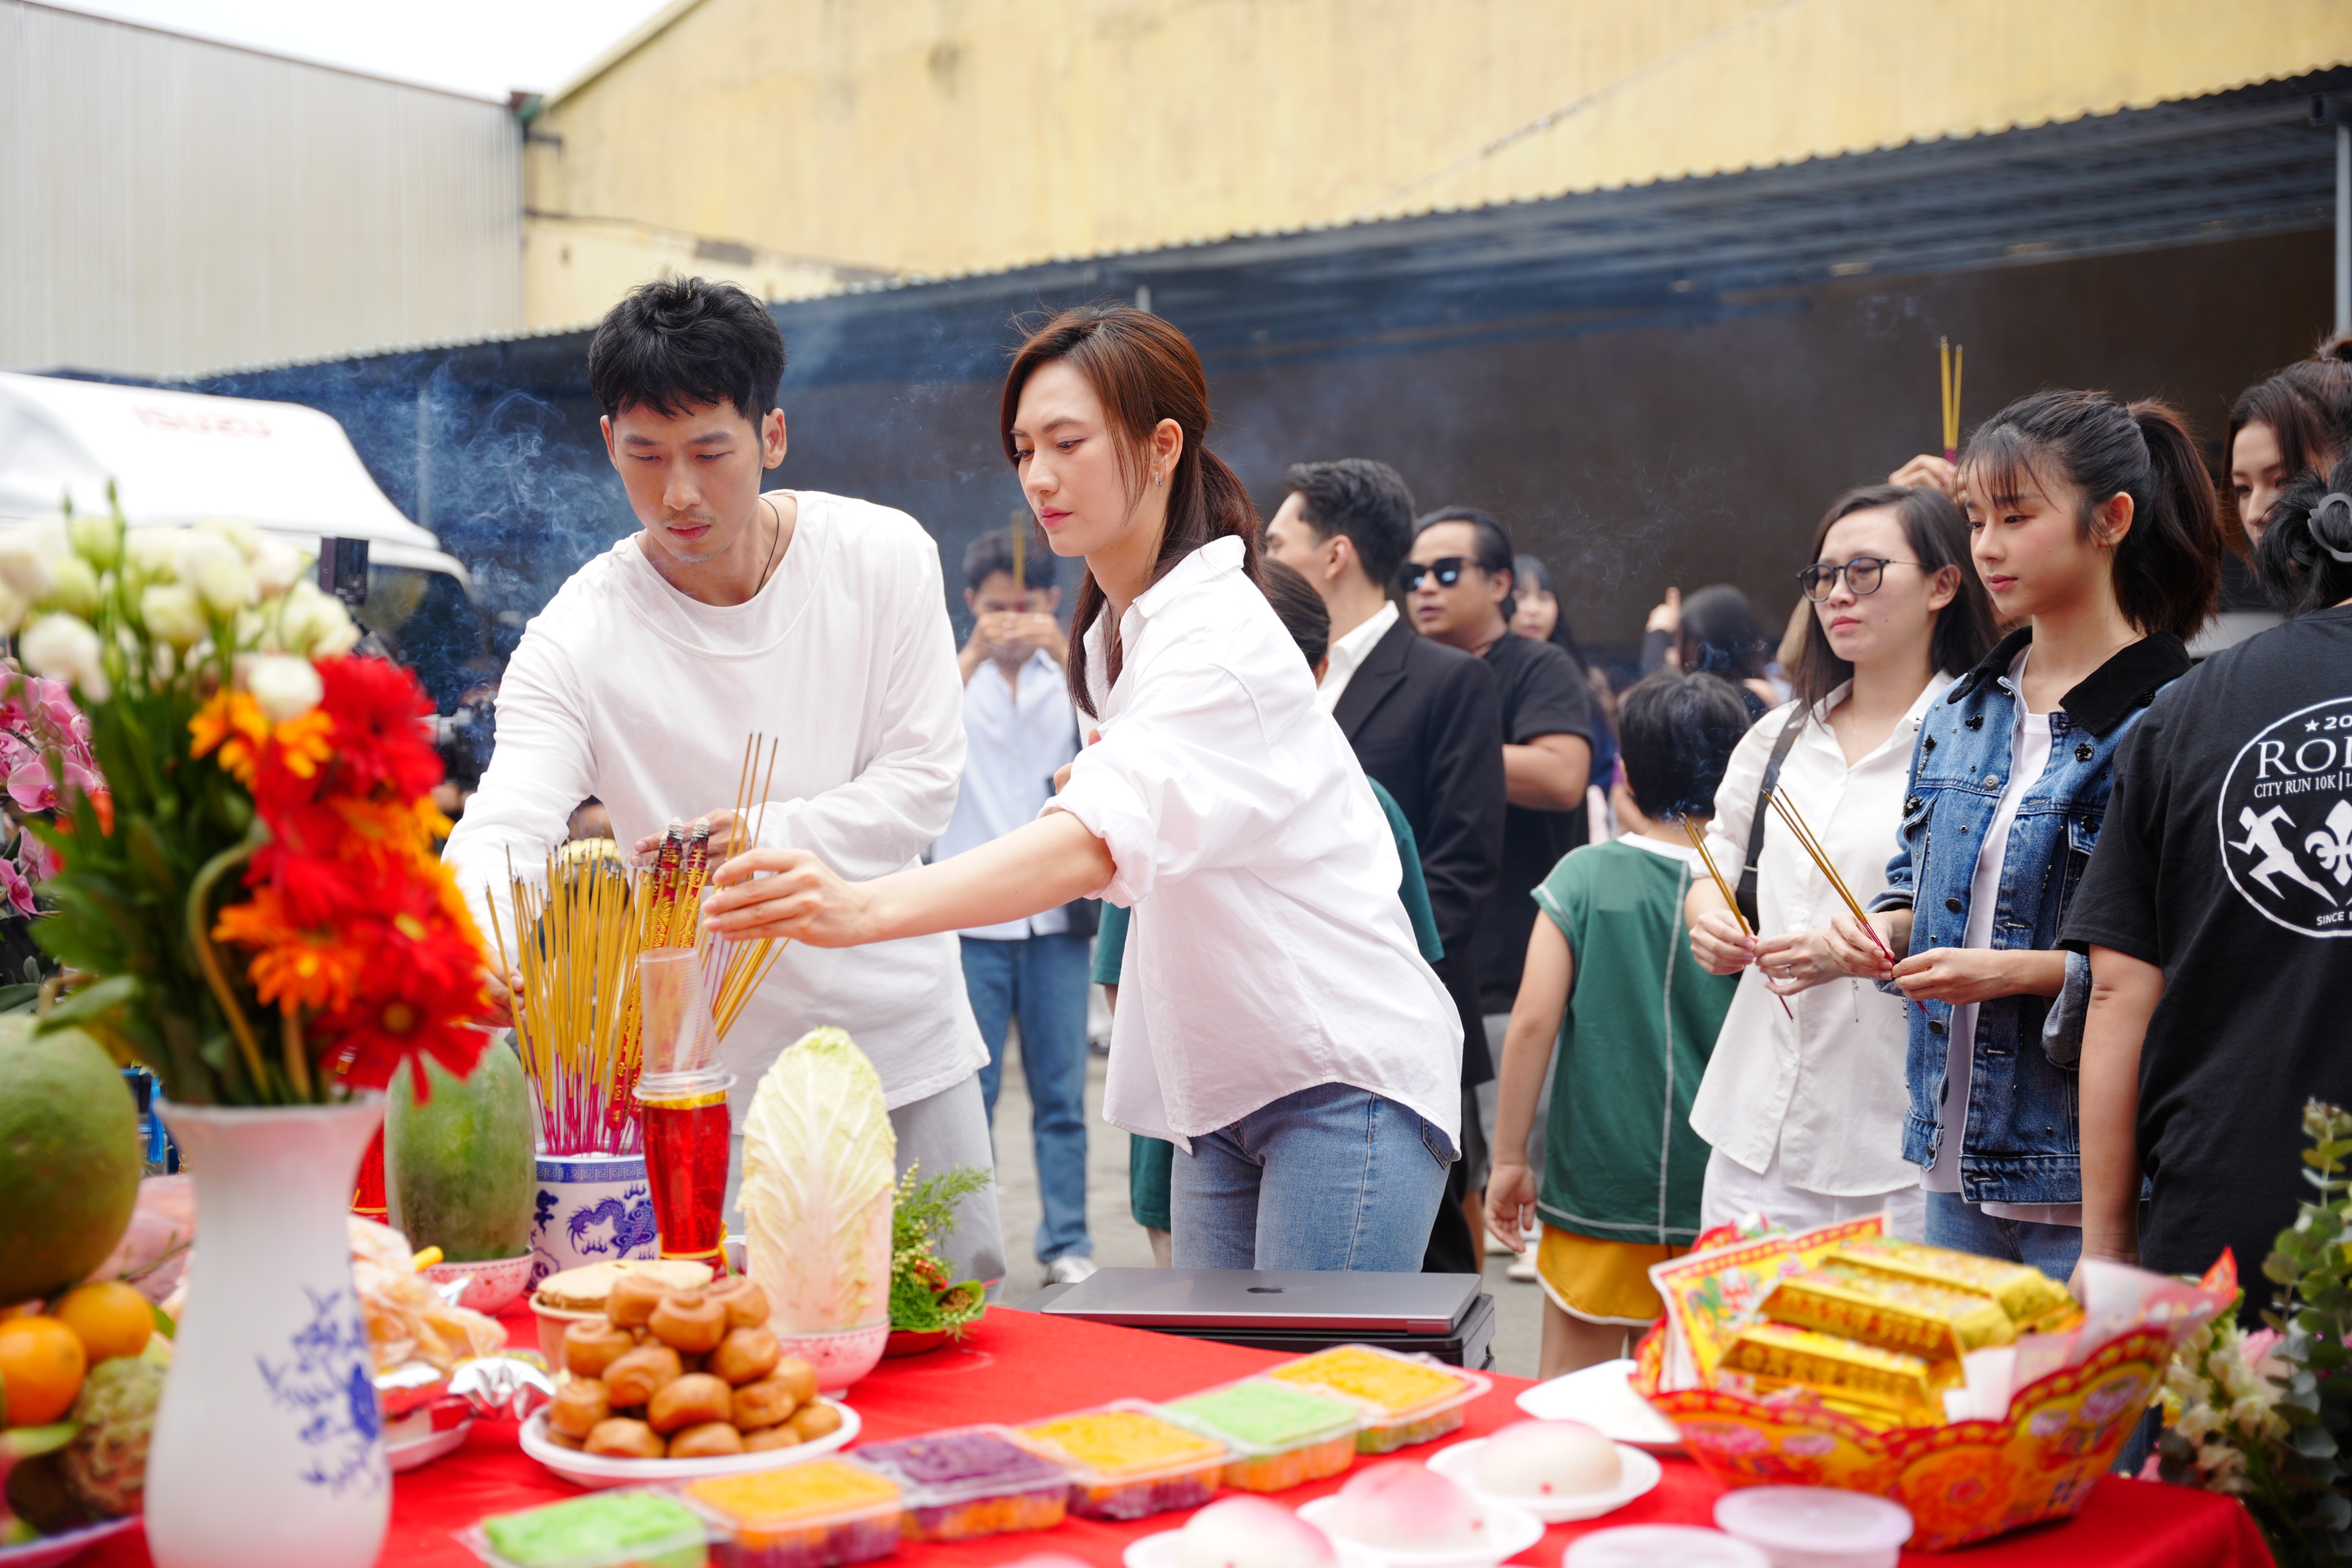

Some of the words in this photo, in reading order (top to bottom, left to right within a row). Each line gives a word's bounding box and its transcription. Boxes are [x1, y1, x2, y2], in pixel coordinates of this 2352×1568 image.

[132, 405, 272, 438] ISUZU
[2254, 781, 2283, 798] CITY
[2285, 777, 2311, 794] RUN
[2315, 775, 2336, 790] 10K
[2316, 911, 2345, 925] SINCE
